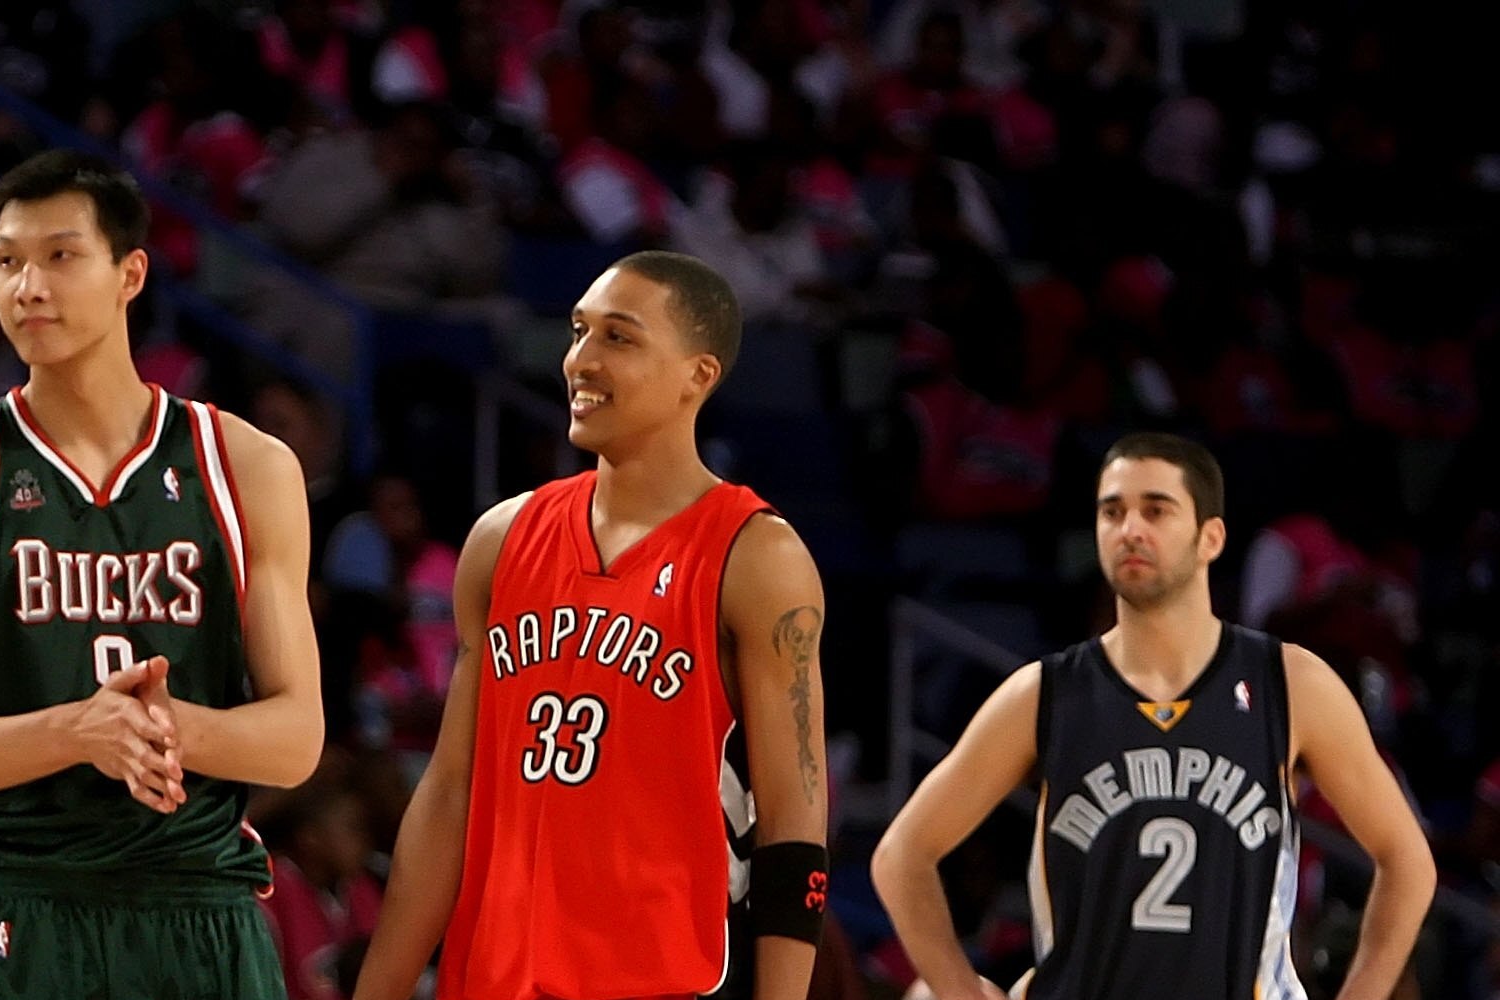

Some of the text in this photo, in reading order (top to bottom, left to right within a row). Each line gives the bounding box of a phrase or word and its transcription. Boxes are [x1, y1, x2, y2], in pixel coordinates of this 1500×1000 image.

[10, 536, 205, 627] BUCKS
[486, 605, 694, 702] RAPTORS
[521, 691, 610, 786] 33
[1049, 746, 1283, 851] MEMPHIS
[804, 868, 829, 913] 33
[1131, 815, 1199, 933] 2
